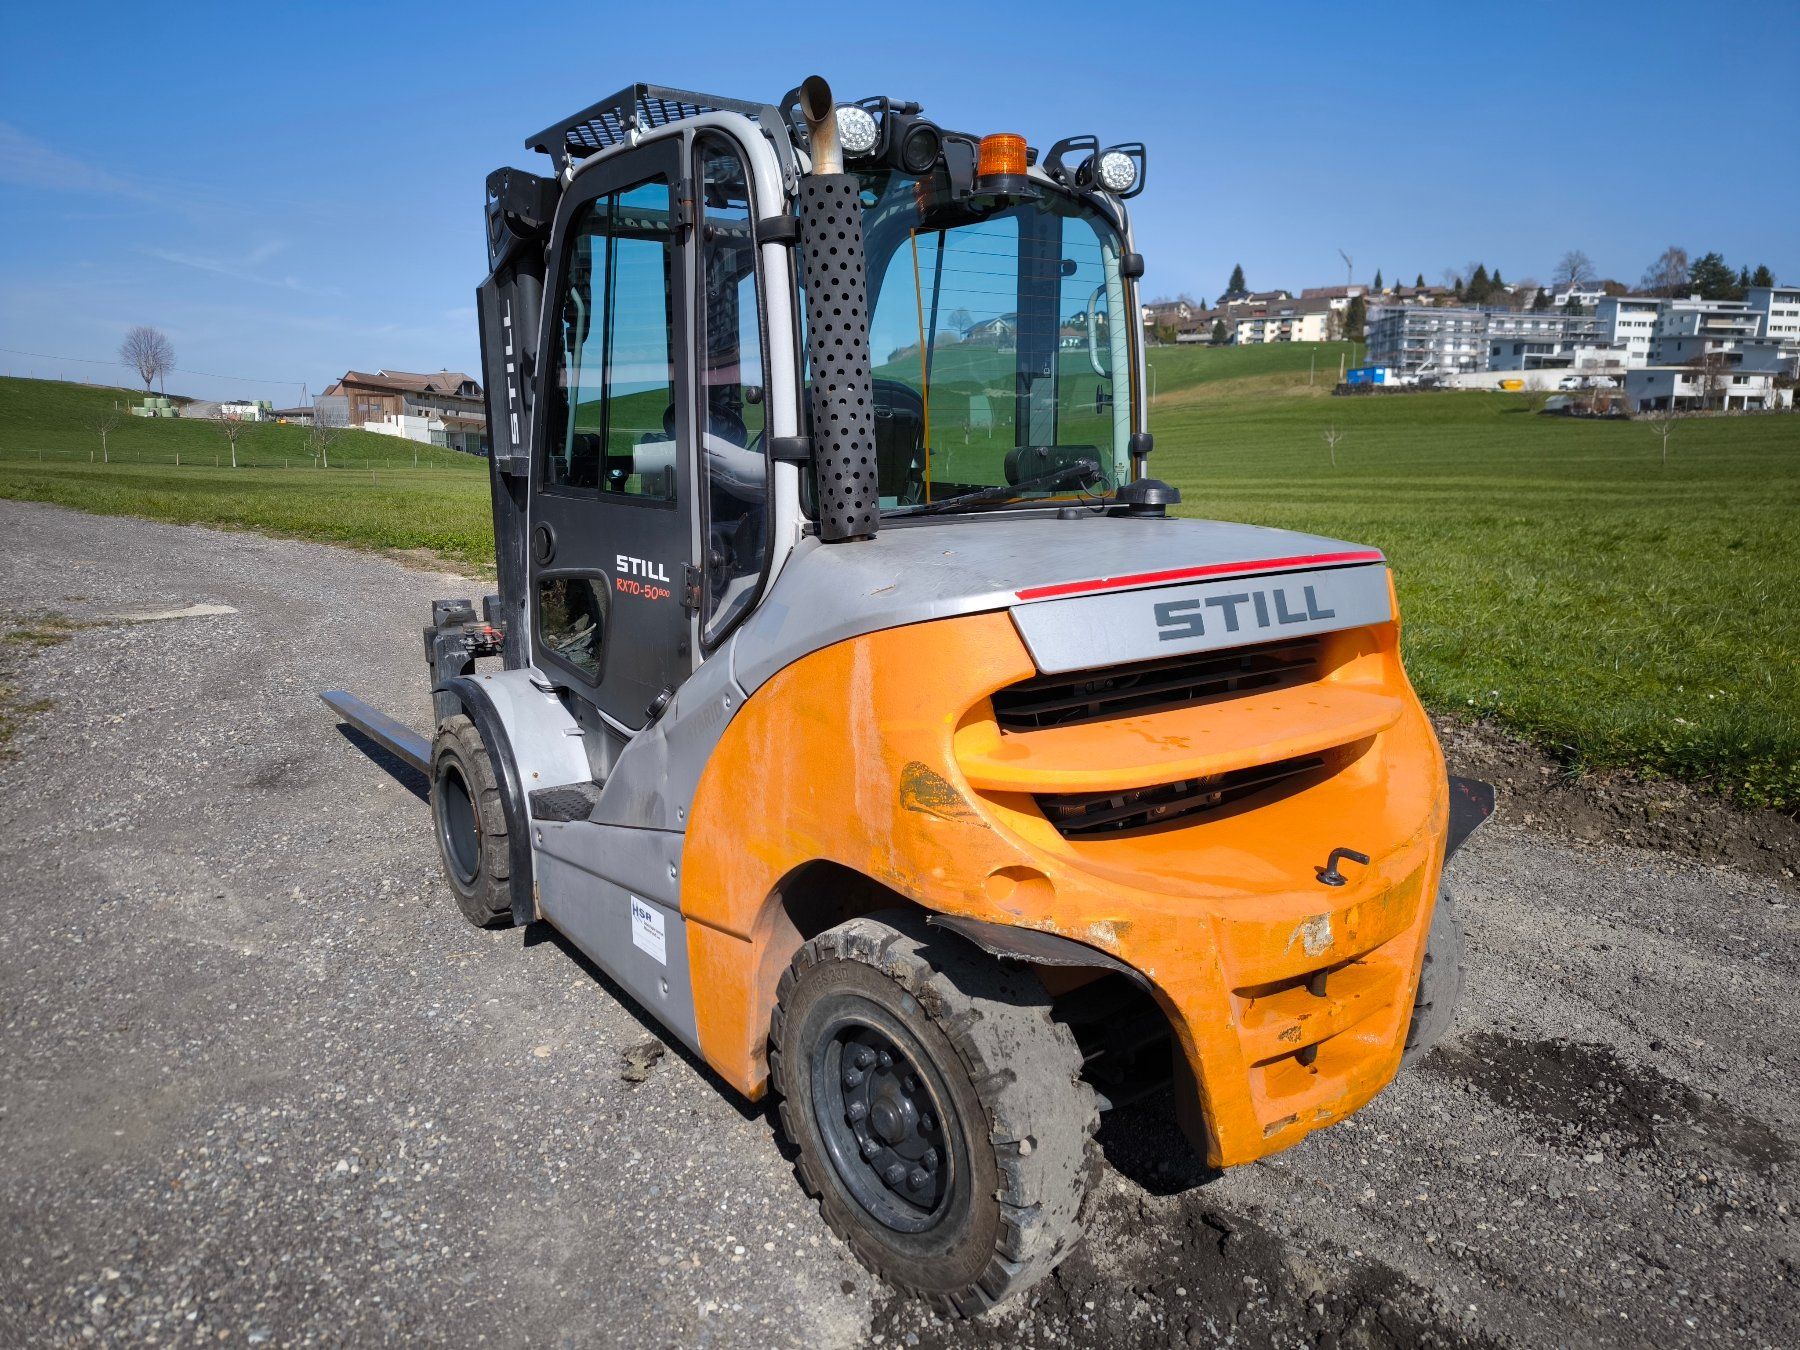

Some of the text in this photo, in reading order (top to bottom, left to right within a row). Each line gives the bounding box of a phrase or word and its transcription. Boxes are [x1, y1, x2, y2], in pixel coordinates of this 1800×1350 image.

[503, 299, 519, 444] STILL
[617, 555, 670, 582] STILL
[1154, 586, 1336, 641] STILL
